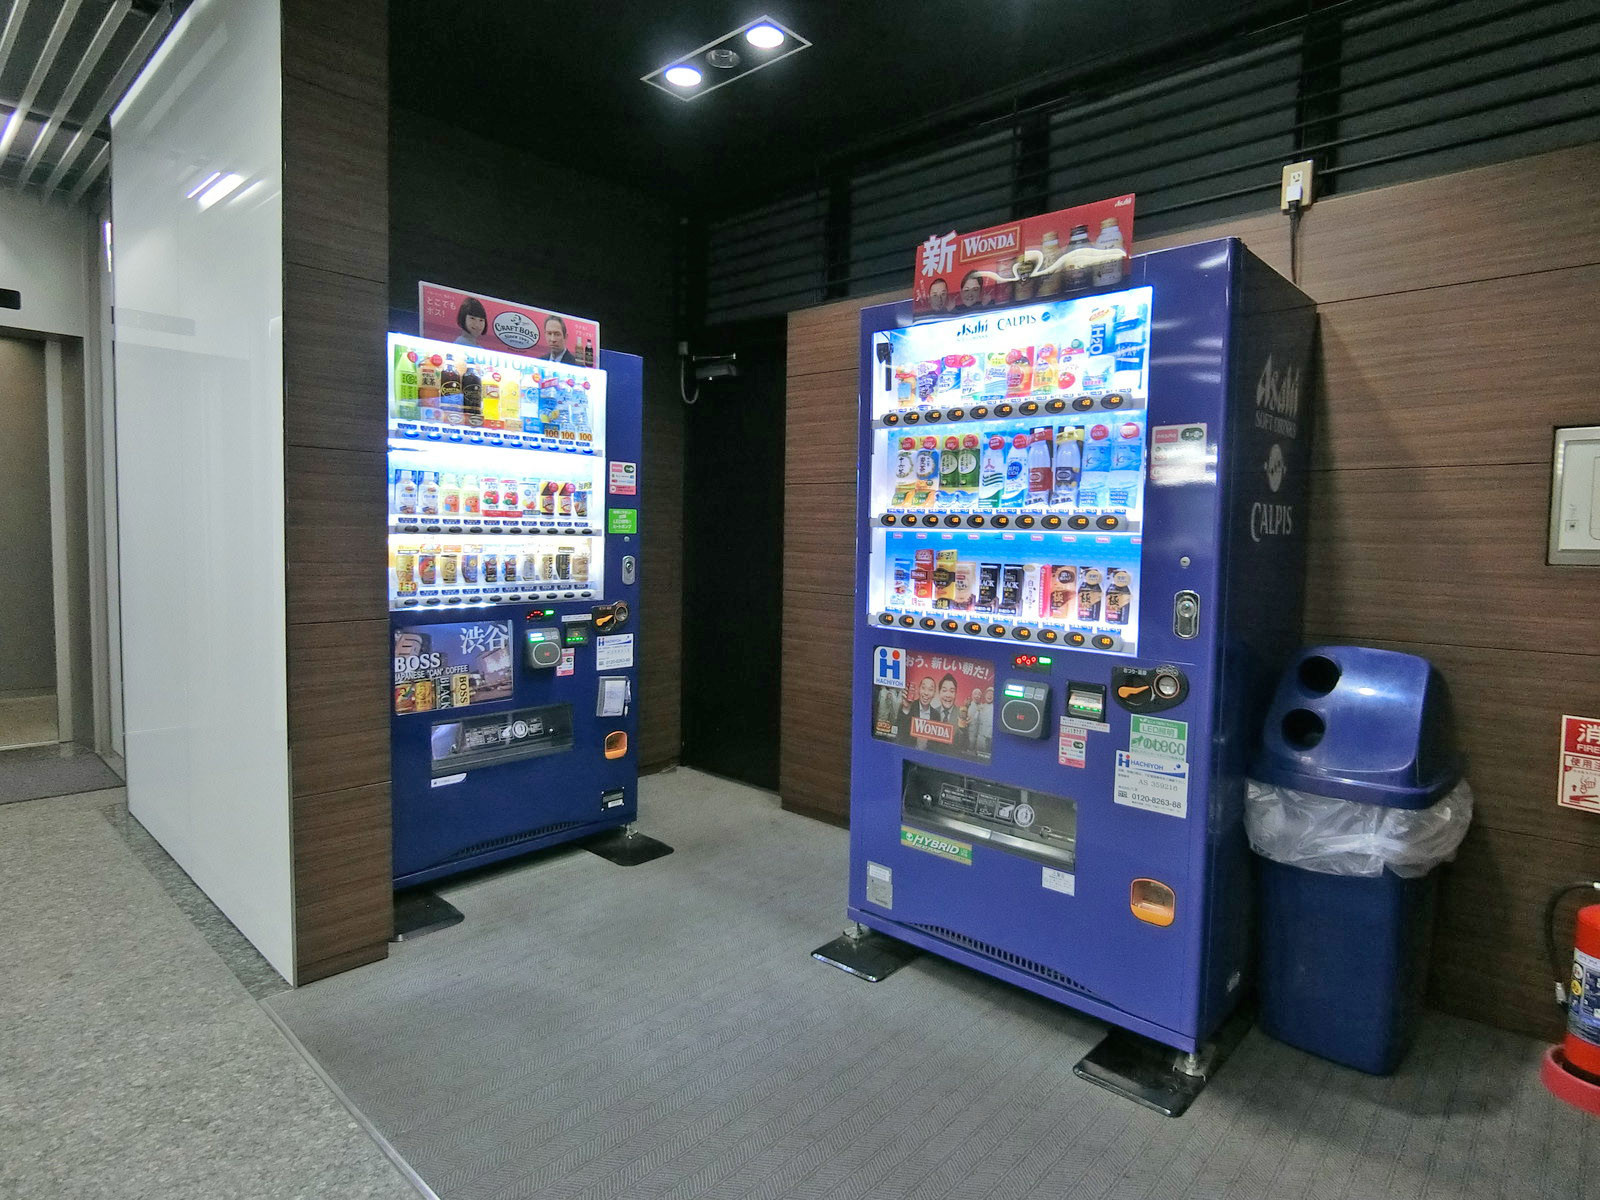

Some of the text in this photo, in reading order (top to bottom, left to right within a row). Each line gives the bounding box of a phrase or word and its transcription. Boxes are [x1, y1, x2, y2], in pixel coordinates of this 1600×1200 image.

[921, 230, 957, 277] 新
[964, 233, 1016, 256] WONDA
[520, 326, 538, 340] BOSS
[956, 315, 1036, 336] Asahi CALPIS
[1256, 353, 1300, 420] Asahi
[545, 430, 592, 441] 100 100 100
[1250, 502, 1293, 542] CALPIS
[460, 624, 509, 654] 渋谷
[395, 653, 441, 672] BOSS
[446, 664, 468, 674] COFFEE
[440, 677, 451, 709] BLACK
[460, 676, 468, 704] BOSS
[914, 718, 950, 738] WONDA
[1131, 760, 1164, 770] HACHIYOH
[1132, 793, 1182, 808] 0120-8263-88
[913, 835, 960, 854] HYBRID
